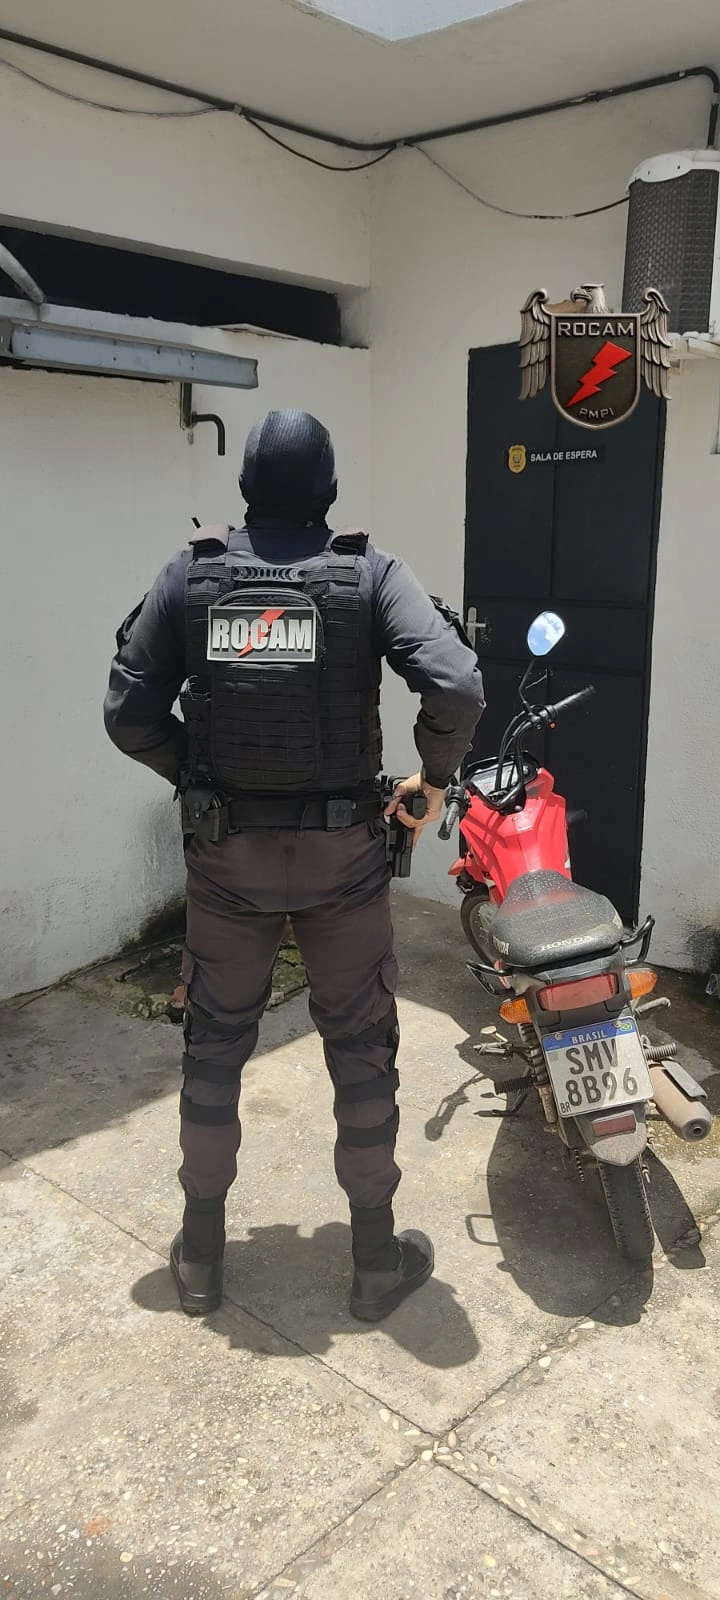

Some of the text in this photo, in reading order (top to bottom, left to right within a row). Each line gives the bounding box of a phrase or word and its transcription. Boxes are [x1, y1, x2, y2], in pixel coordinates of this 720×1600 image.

[530, 449, 598, 462] SALA DE ESPERA
[212, 618, 312, 650] ROCAM
[540, 935, 594, 951] HONDA
[571, 1030, 607, 1044] BRASIL
[565, 1038, 618, 1075] SMV
[565, 1067, 638, 1106] 8B96
[560, 1101, 571, 1113] BR
